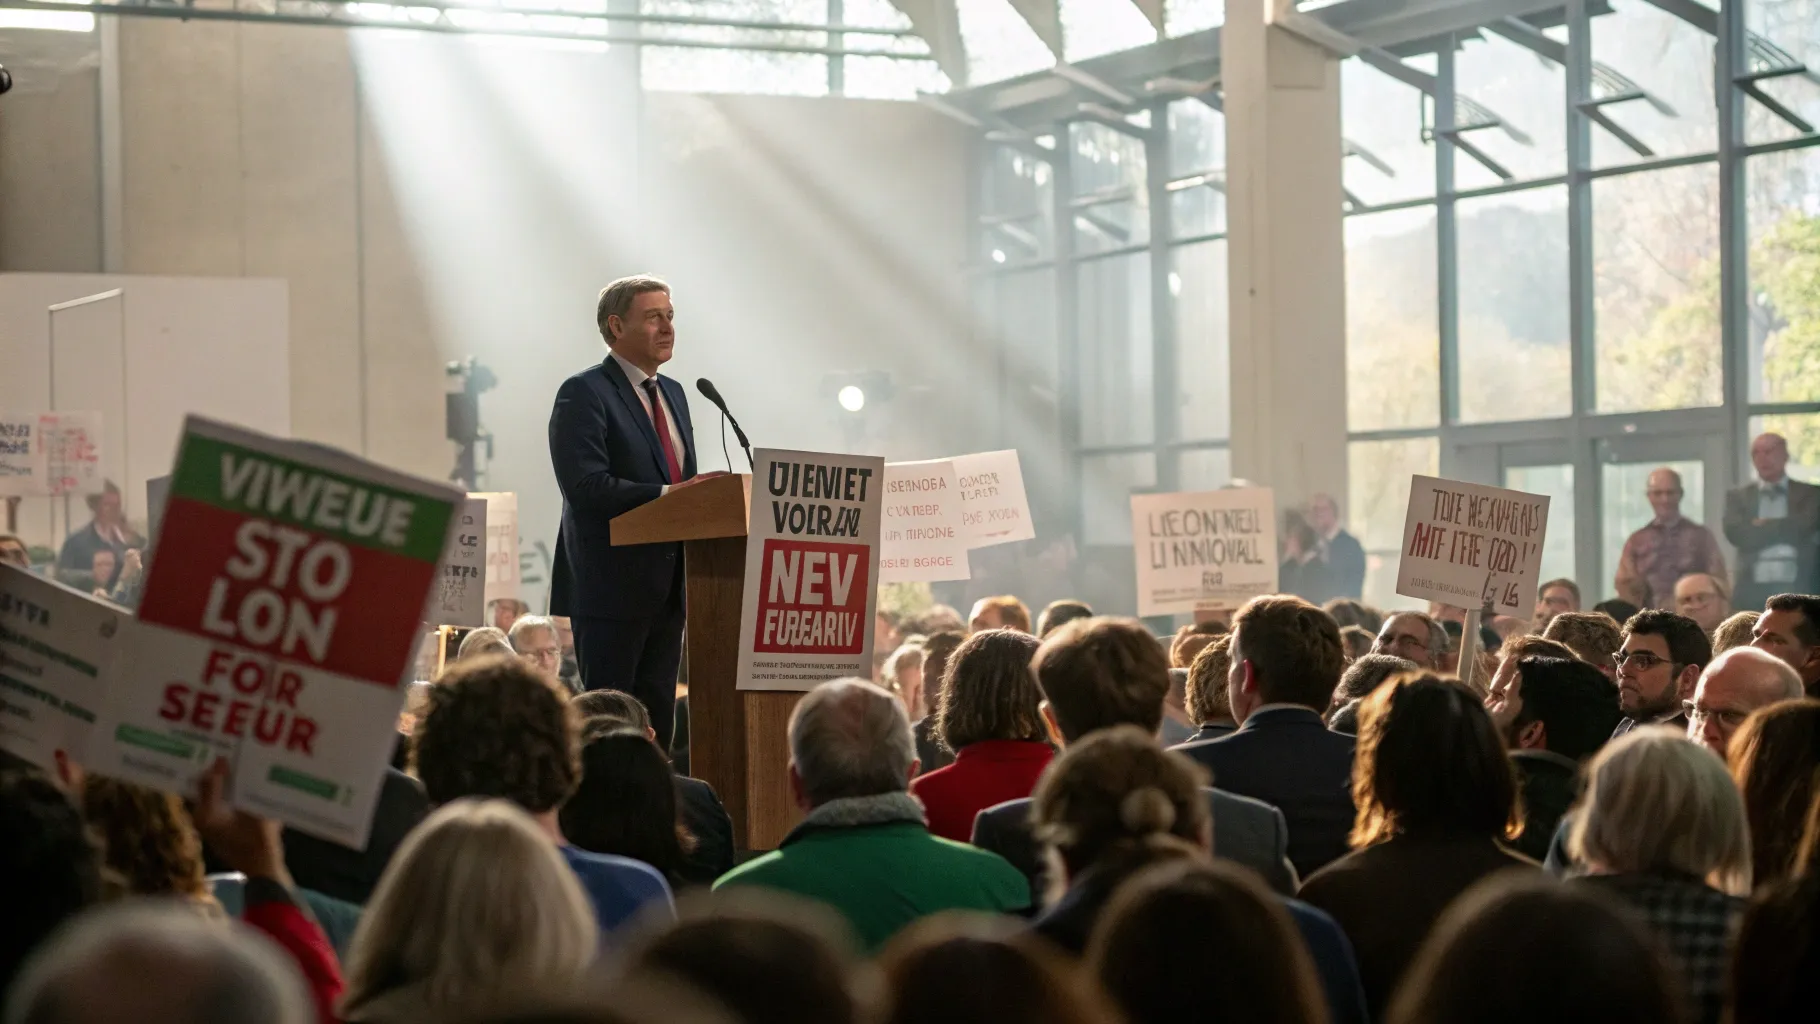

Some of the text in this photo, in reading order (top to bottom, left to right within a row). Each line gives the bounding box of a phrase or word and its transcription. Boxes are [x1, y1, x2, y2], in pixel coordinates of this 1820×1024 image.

[220, 452, 416, 546] VIWEUE
[226, 518, 352, 602] STO
[768, 549, 858, 606] NEV
[201, 578, 338, 663] LON
[202, 648, 304, 708] FOR
[158, 683, 323, 756] SEEUR
